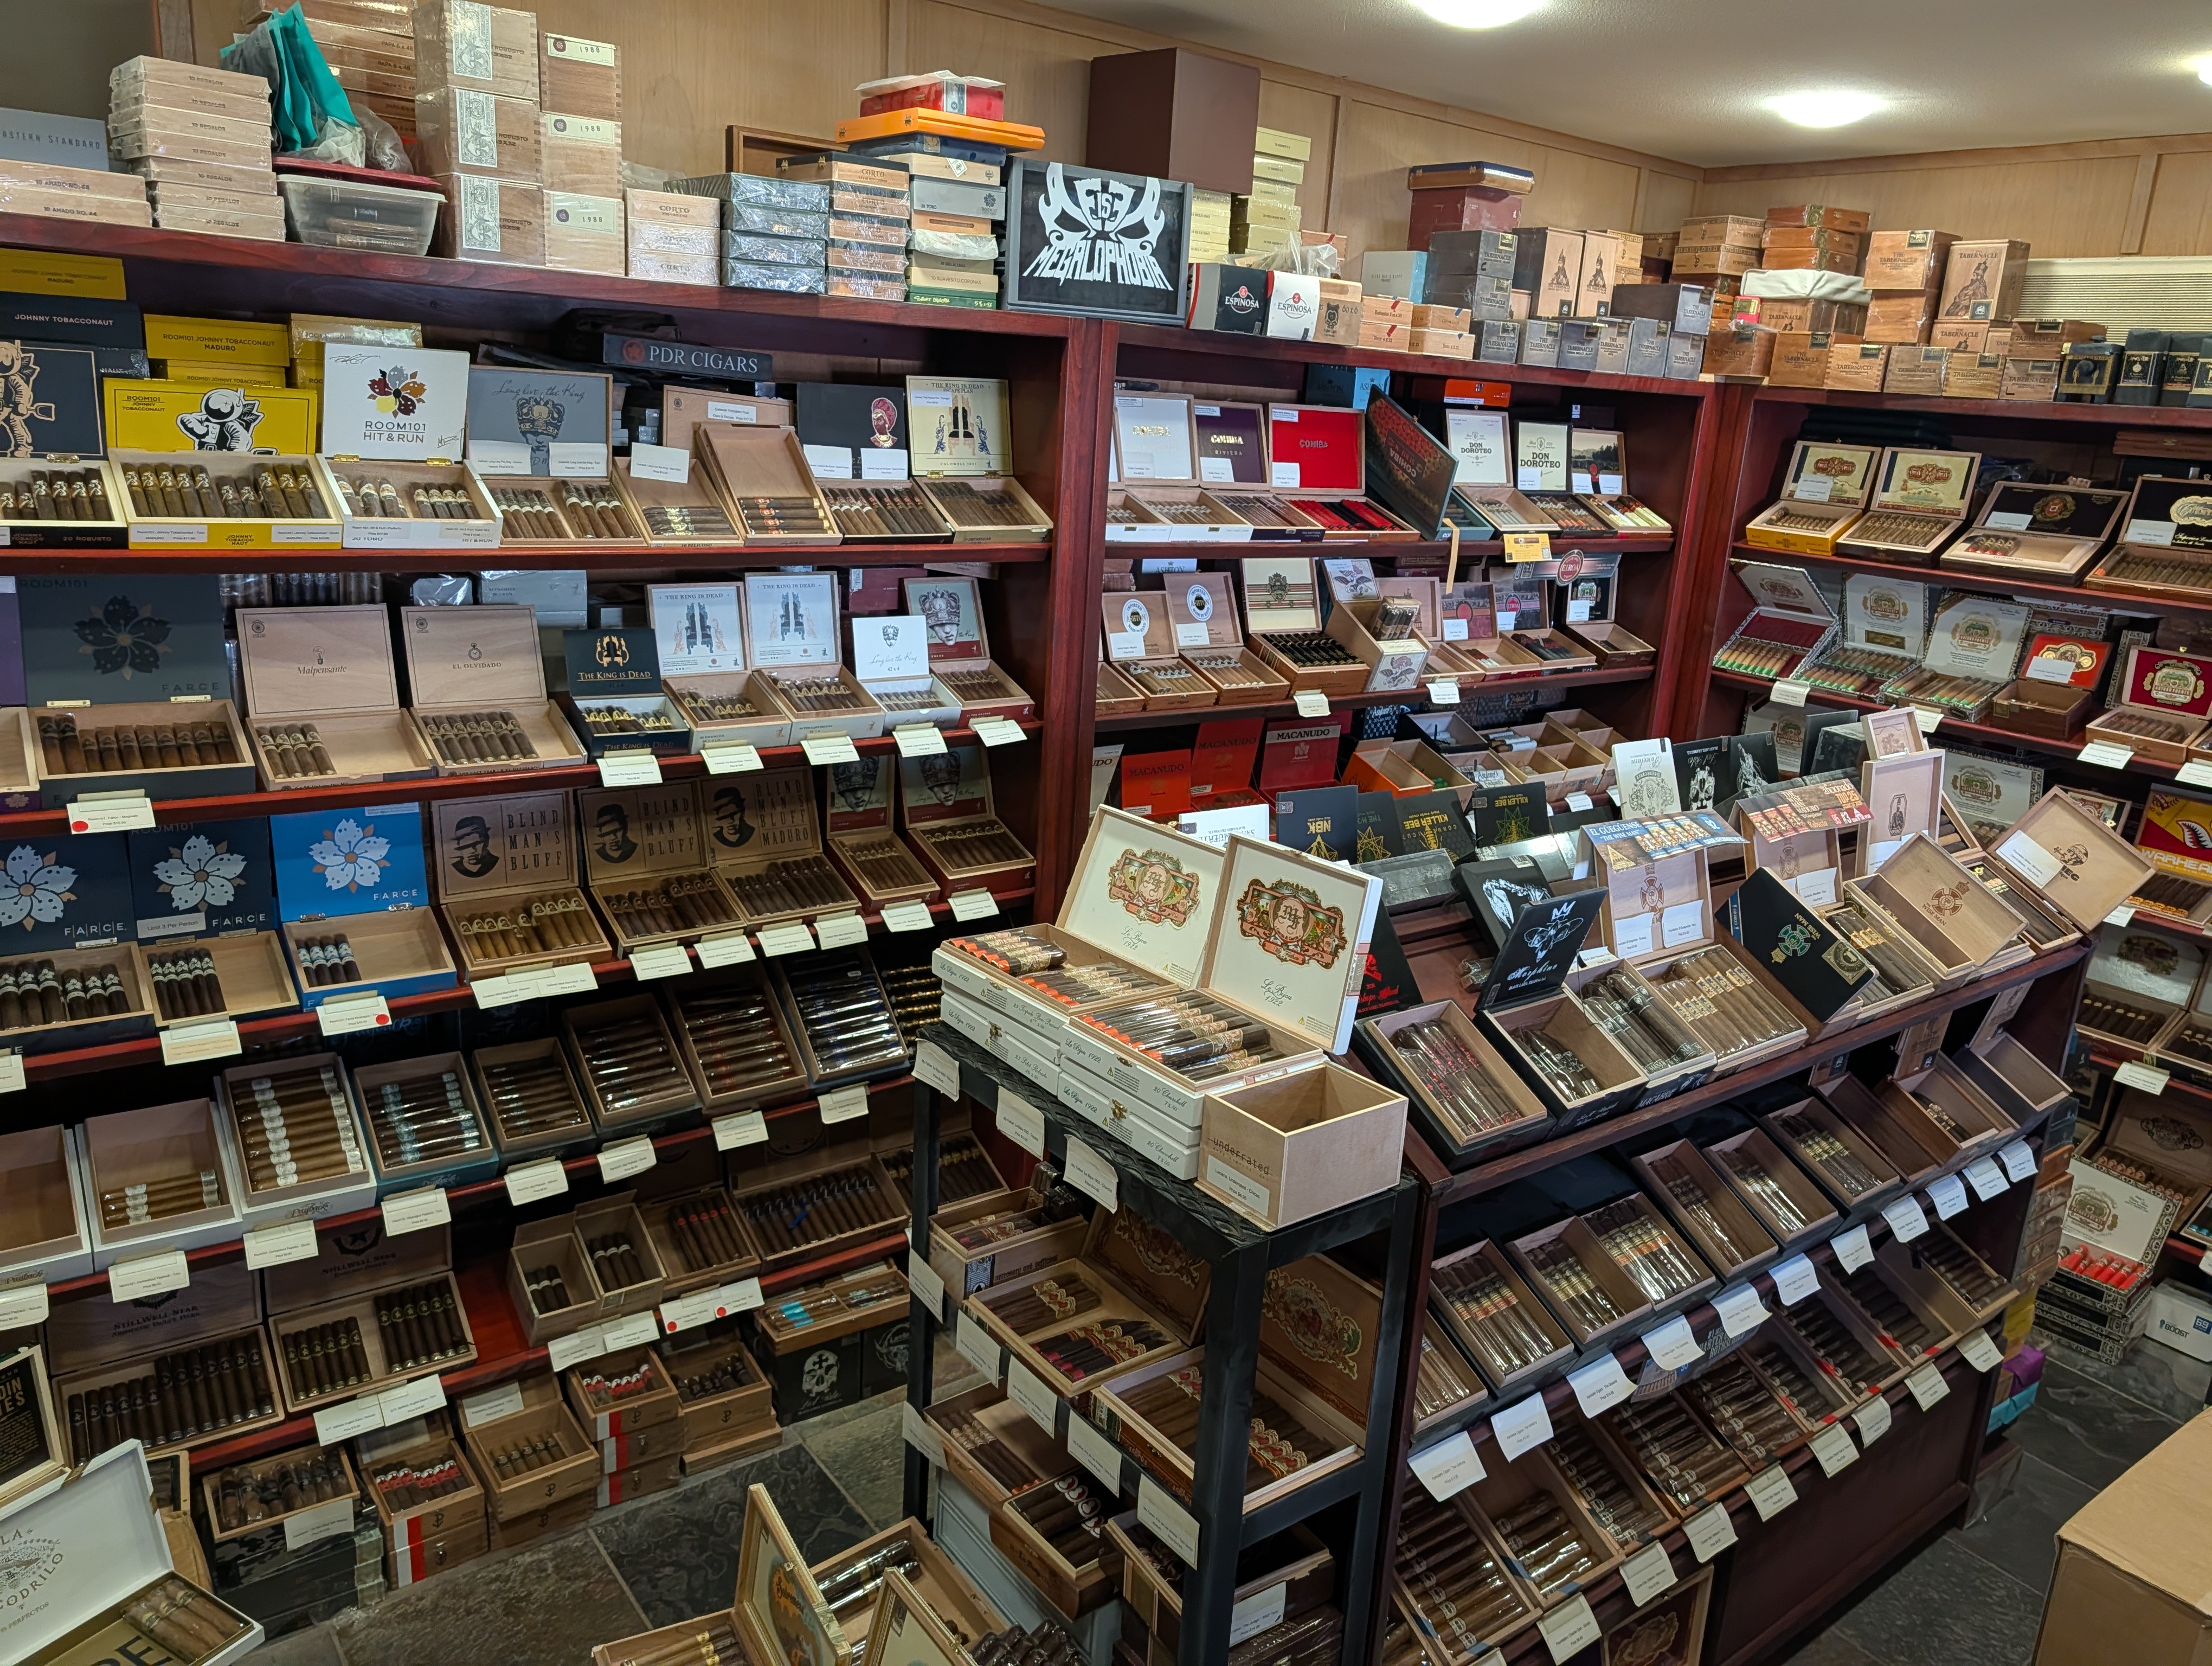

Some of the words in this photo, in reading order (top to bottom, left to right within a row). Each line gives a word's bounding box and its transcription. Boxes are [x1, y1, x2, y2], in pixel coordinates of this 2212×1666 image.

[494, 45, 525, 55] ROBUSTO
[198, 123, 226, 132] REGALOS
[48, 134, 101, 150] STANDARD
[499, 133, 529, 142] ROBUSTO
[199, 149, 226, 158] REGALOS
[206, 174, 233, 182] REGALOS
[861, 168, 885, 179] CORTO
[52, 207, 75, 215] AMADO
[659, 204, 691, 214] CORTO
[502, 217, 533, 227] ROBUSTO
[1483, 251, 1512, 262] TABERNACLE
[1879, 256, 1918, 264] TABERNACLE
[1959, 252, 1998, 260] TABERNACLE
[1022, 239, 1174, 291] MEGALOPHOBIA
[1225, 297, 1259, 309] ESPINOSA
[1480, 296, 1507, 306] TABERNACLE
[1277, 302, 1312, 315] ESPINOSA
[52, 316, 113, 326] TOBACCONAUT
[196, 336, 224, 344] JOHNNY
[226, 337, 275, 348] TOBACCONAUT
[204, 344, 236, 352] MADURO
[1485, 340, 1515, 349] TABERNACLE
[1529, 341, 1556, 351] TABERNACLE
[1599, 341, 1625, 350] TABERNACLE
[1638, 342, 1661, 352] TABERNACLE
[1567, 345, 1594, 355] TABERNACLE
[649, 346, 685, 366] PDR
[691, 351, 757, 374] CIGARS
[1674, 355, 1696, 363] TABERNACLE
[1783, 356, 1819, 364] TABERNACLE
[1836, 363, 1874, 372] TABERNACLE
[493, 380, 520, 398] Long
[523, 385, 538, 396] live
[562, 383, 586, 402] King
[364, 421, 427, 431] ROOM101
[1132, 425, 1171, 437] COHIBA
[363, 432, 384, 442] HIT
[386, 432, 395, 441] &
[397, 433, 424, 443] RUN
[1211, 434, 1244, 445] COHIBA
[1298, 439, 1328, 448] COHIBA
[1532, 452, 1550, 460] DON
[1520, 459, 1561, 469] DOROTEO
[20, 579, 88, 589] ROOM101
[871, 654, 886, 665] Long
[905, 653, 918, 665] King
[297, 664, 347, 676] Malpensante
[162, 683, 220, 692] FARCE
[1277, 728, 1330, 740] MACANUDO
[1198, 737, 1257, 749] MACANUDO
[1129, 764, 1185, 776] MACANUDO
[1822, 782, 1854, 795] aficionado
[1508, 796, 1528, 806] KILLER
[1782, 791, 1797, 799] THE
[1835, 793, 1848, 804] TOP
[1848, 791, 1860, 801] 25
[643, 798, 689, 815] BLIND
[1796, 805, 1820, 813] MADURO
[507, 810, 559, 829] BLIND
[1421, 814, 1449, 828] KILLER
[1832, 815, 1841, 824] 95
[1841, 812, 1851, 824] #3
[645, 816, 692, 836] MAN'S
[1307, 820, 1332, 835] NBK
[1403, 820, 1420, 830] BEE
[1709, 819, 1721, 830] 92
[762, 826, 809, 847] MADURO
[1590, 828, 1598, 837] EL
[509, 830, 560, 850] MAN'S
[648, 838, 695, 856] BLUFF
[511, 851, 563, 871] BLUFF
[373, 889, 418, 901] FARCE
[212, 913, 267, 927] FARCE
[1794, 912, 1809, 928] MAN
[1921, 903, 1936, 918] WISE
[1934, 913, 1947, 927] MAN
[180, 920, 198, 928] Person
[1131, 931, 1148, 946] Bijou
[1809, 925, 1821, 940] WISE
[1123, 940, 1139, 951] 1922
[959, 970, 969, 983] 1922
[1507, 960, 1558, 982] Morphine
[1261, 979, 1276, 992] Le
[1270, 987, 1293, 1002] Bijou
[1264, 994, 1283, 1008] 1922
[1074, 1042, 1086, 1056] Bijou
[1088, 1052, 1102, 1063] 1922
[1153, 1085, 1161, 1093] 20
[1159, 1087, 1187, 1108] Churchill
[1154, 1143, 1180, 1163] Churchill
[1213, 1136, 1270, 1176] underrated
[1229, 1186, 1238, 1195] Price
[290, 1201, 331, 1219] Payback
[372, 1251, 397, 1263] STAR
[172, 1305, 199, 1319] STAR
[2165, 1323, 2189, 1338] BOOST
[8, 1601, 49, 1630] PERFECTOS
